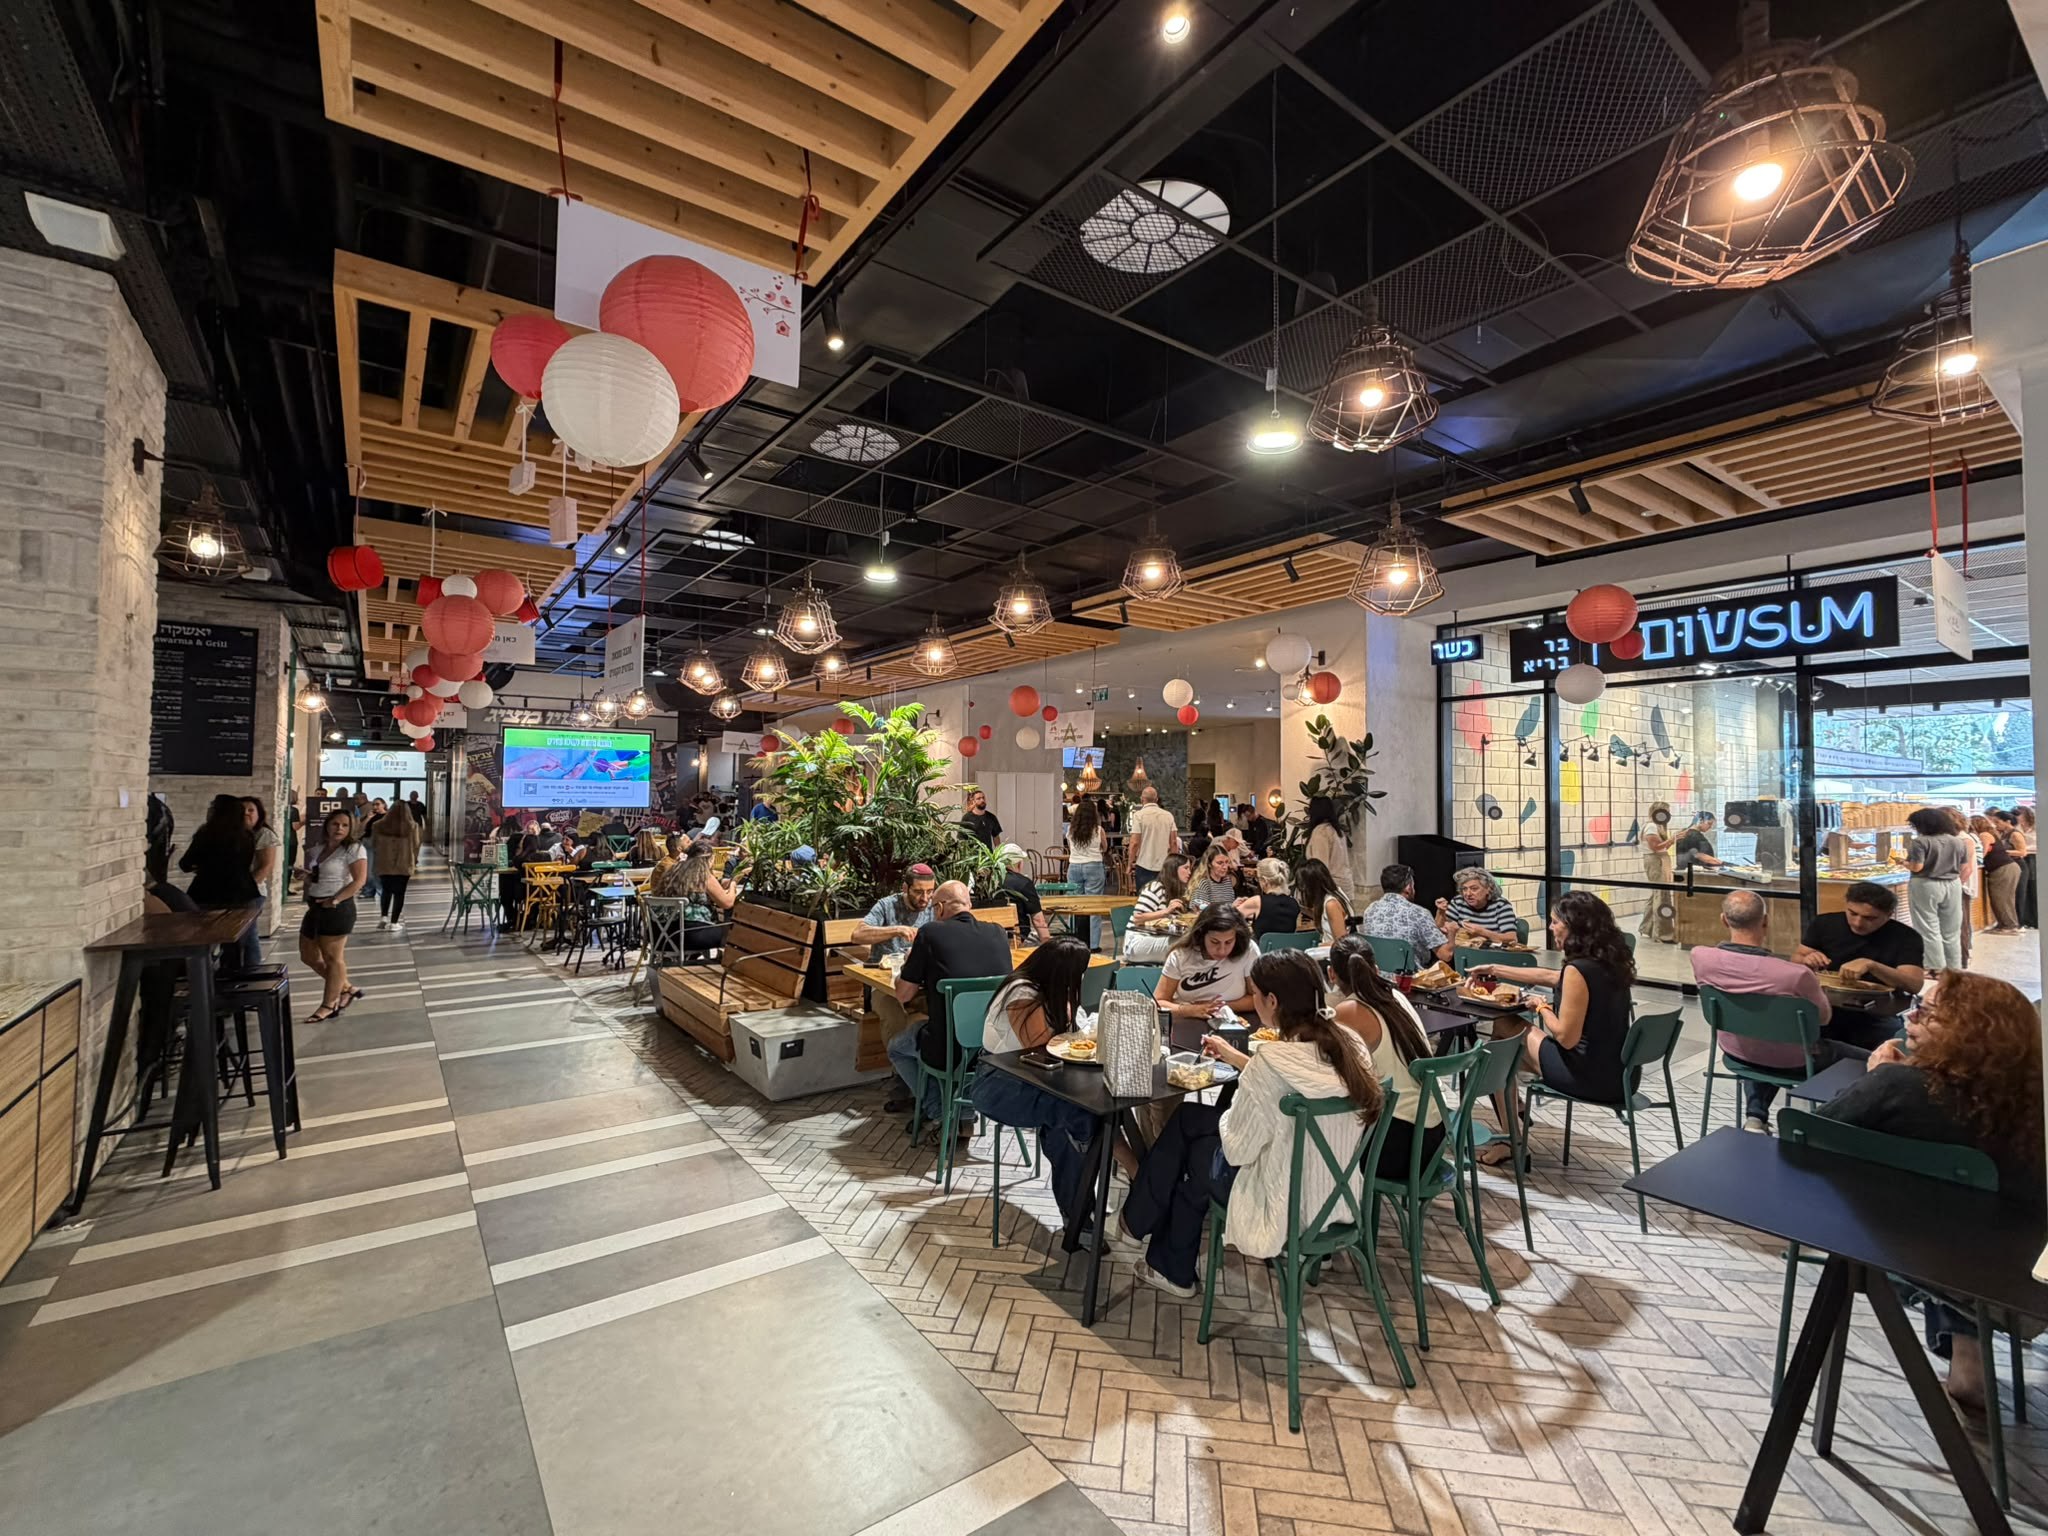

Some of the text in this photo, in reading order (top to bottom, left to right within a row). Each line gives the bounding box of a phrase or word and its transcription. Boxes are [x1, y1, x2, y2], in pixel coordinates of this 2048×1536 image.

[205, 640, 228, 648] Grill
[1432, 640, 1473, 659] כשר
[1544, 638, 1570, 652] בר
[1523, 655, 1570, 673] בריא
